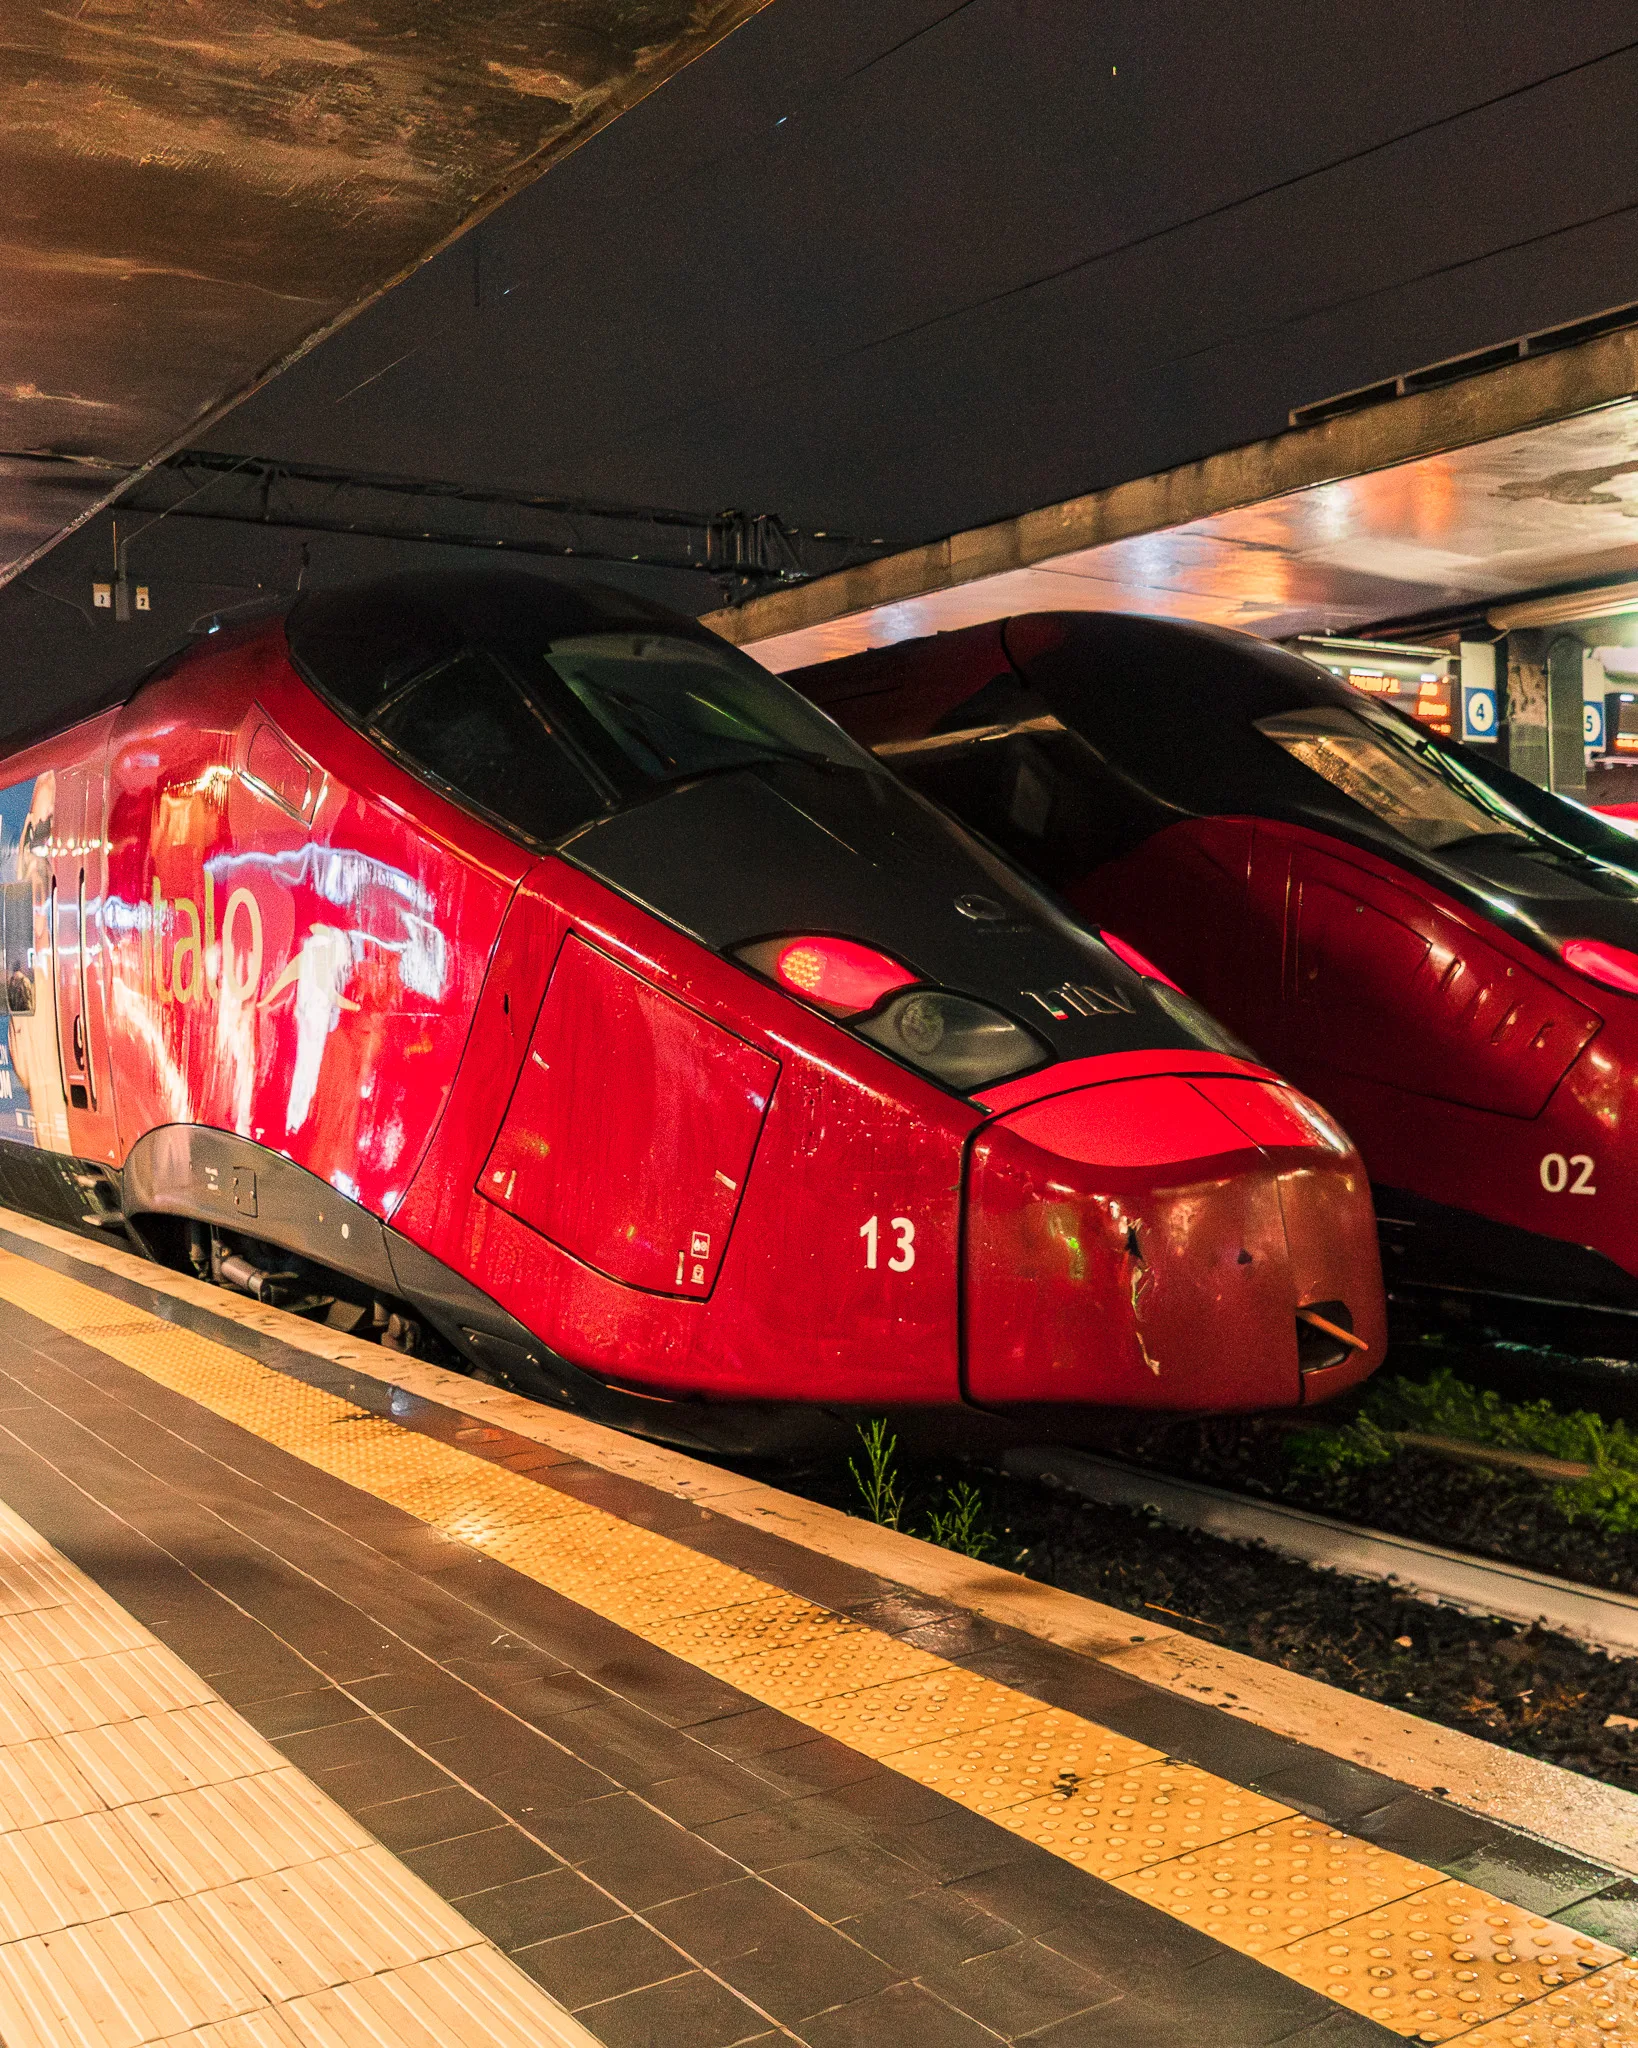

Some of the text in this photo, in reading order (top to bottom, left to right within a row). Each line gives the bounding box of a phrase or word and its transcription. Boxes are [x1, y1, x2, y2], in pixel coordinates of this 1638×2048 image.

[1475, 703, 1485, 720] 4
[1585, 715, 1594, 733] 5
[1539, 1152, 1596, 1195] 02
[860, 1215, 915, 1272] 13
